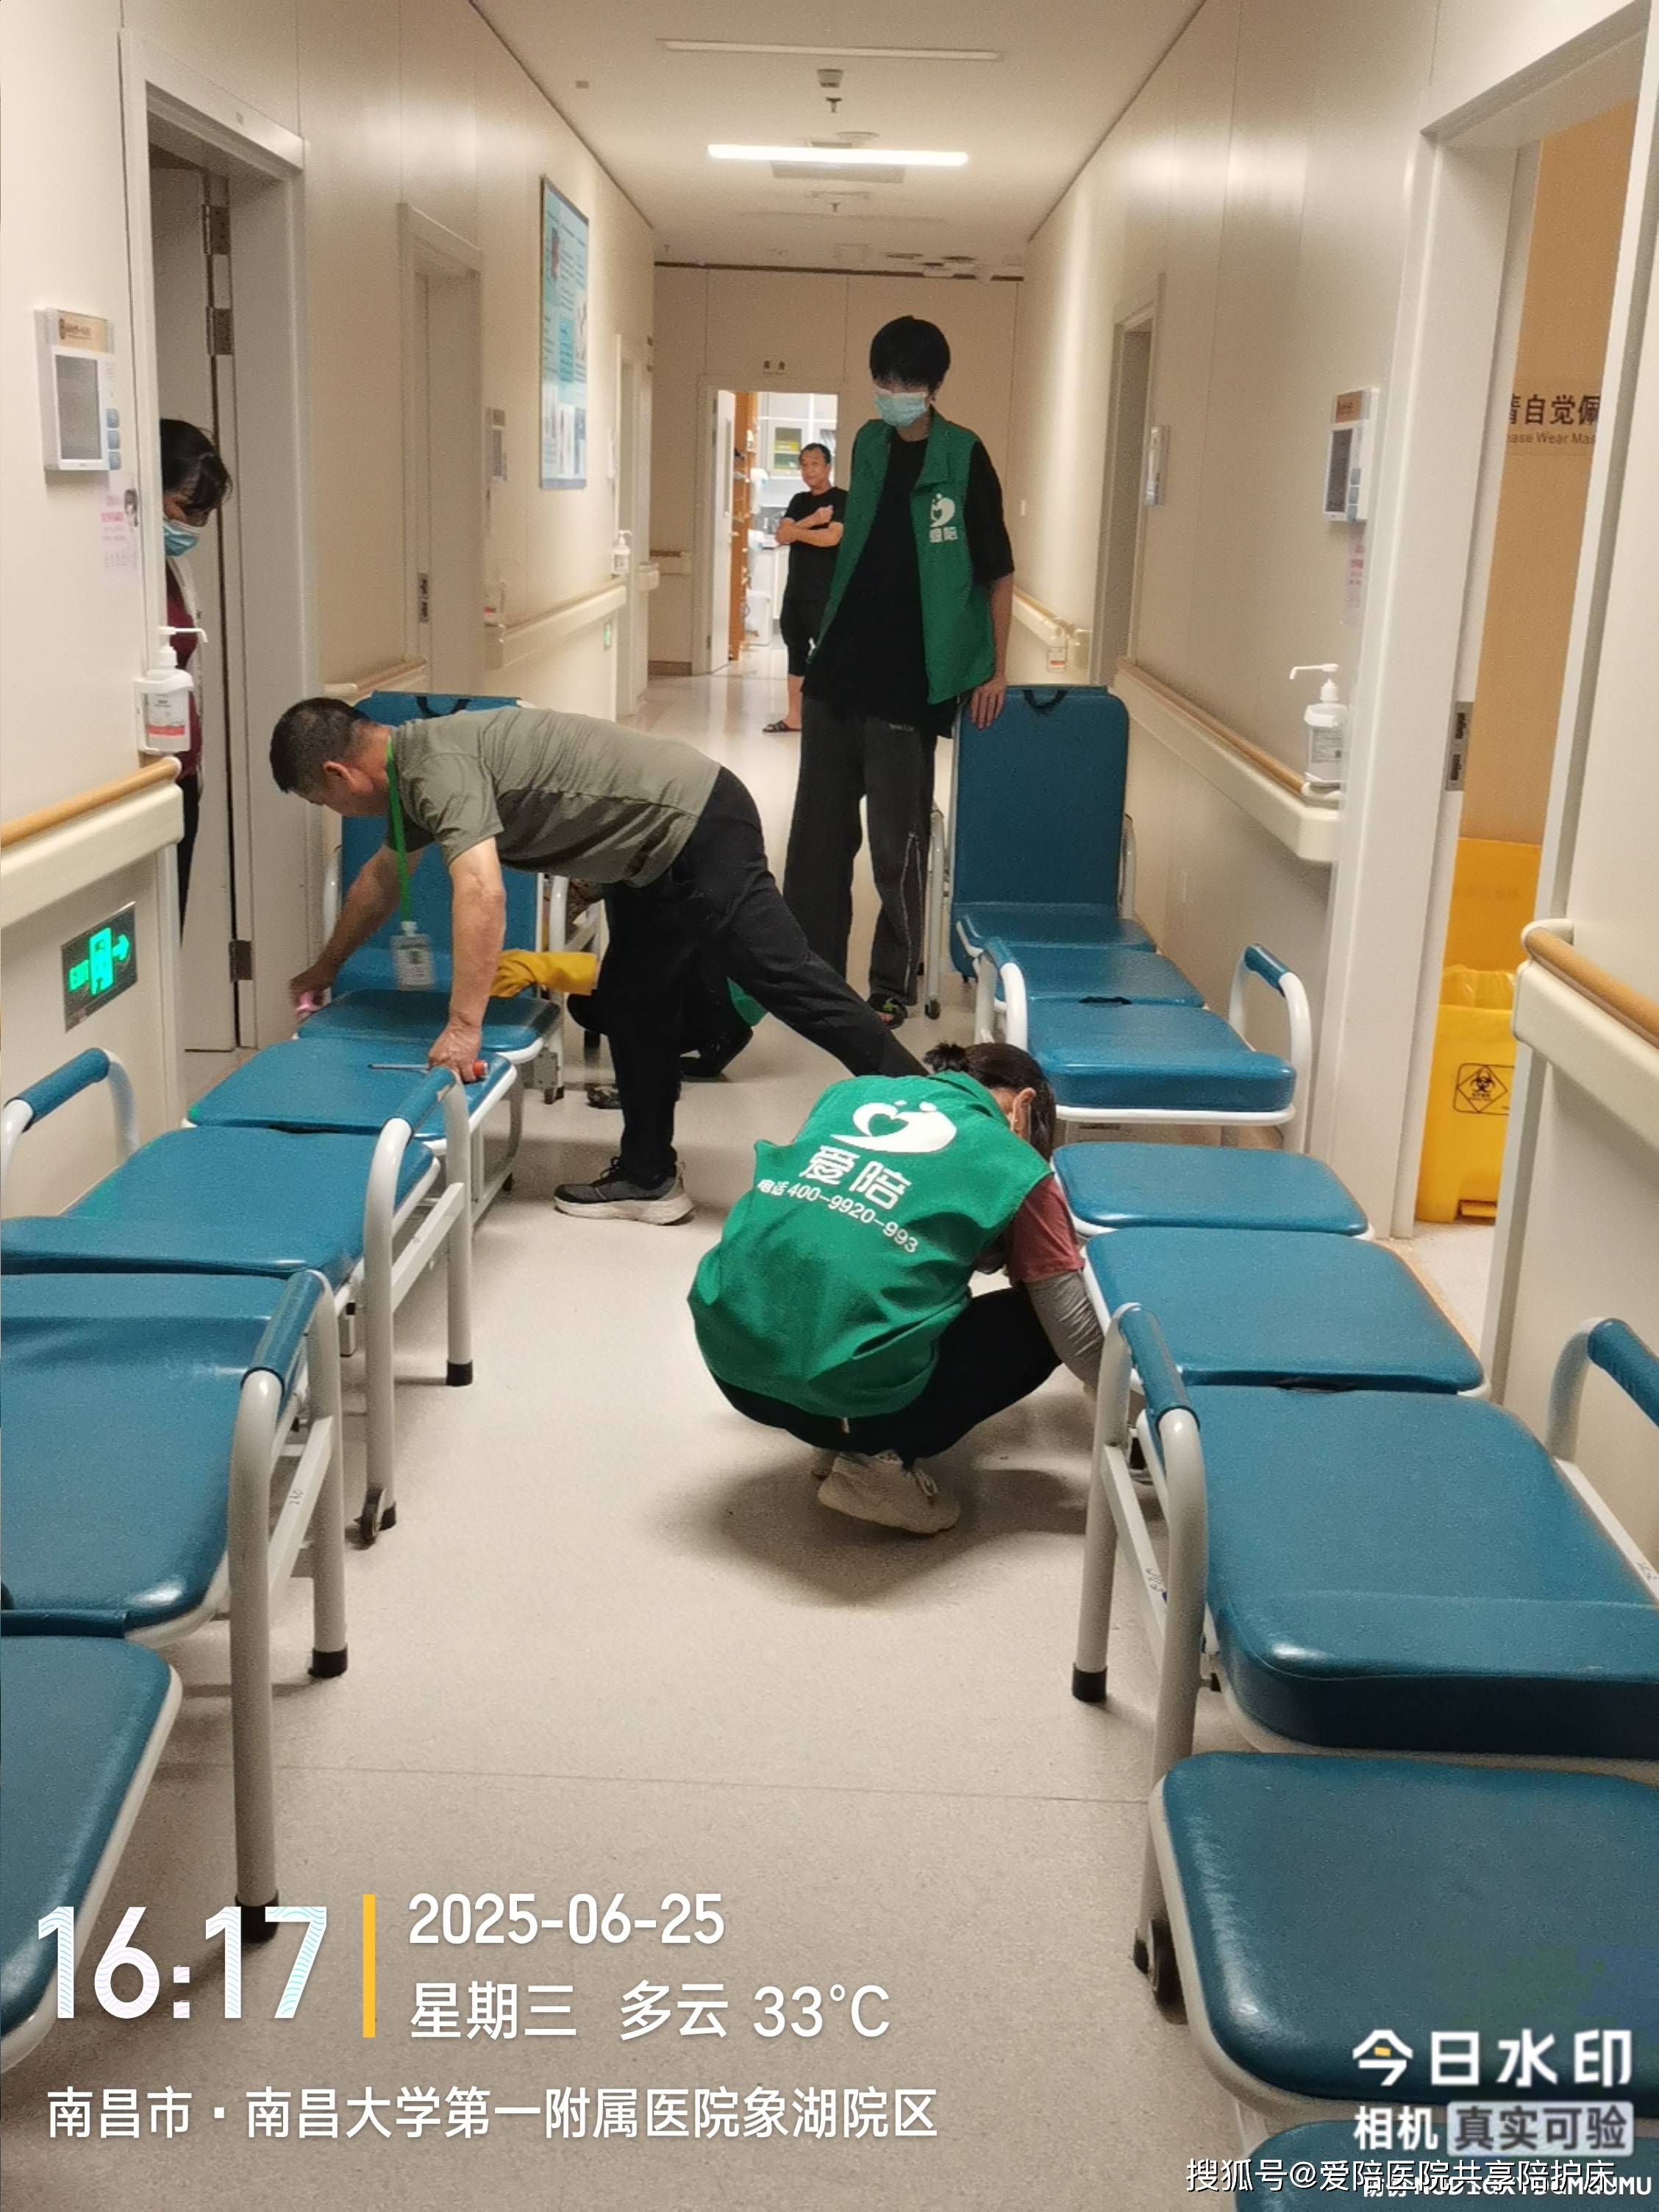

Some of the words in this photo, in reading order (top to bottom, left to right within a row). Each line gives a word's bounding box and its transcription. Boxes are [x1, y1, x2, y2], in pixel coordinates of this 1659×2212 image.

[1535, 432, 1570, 444] Wear
[799, 1145, 912, 1210] 爱陪
[757, 1179, 789, 1196] 电话
[787, 1182, 918, 1253] 400-9920-993
